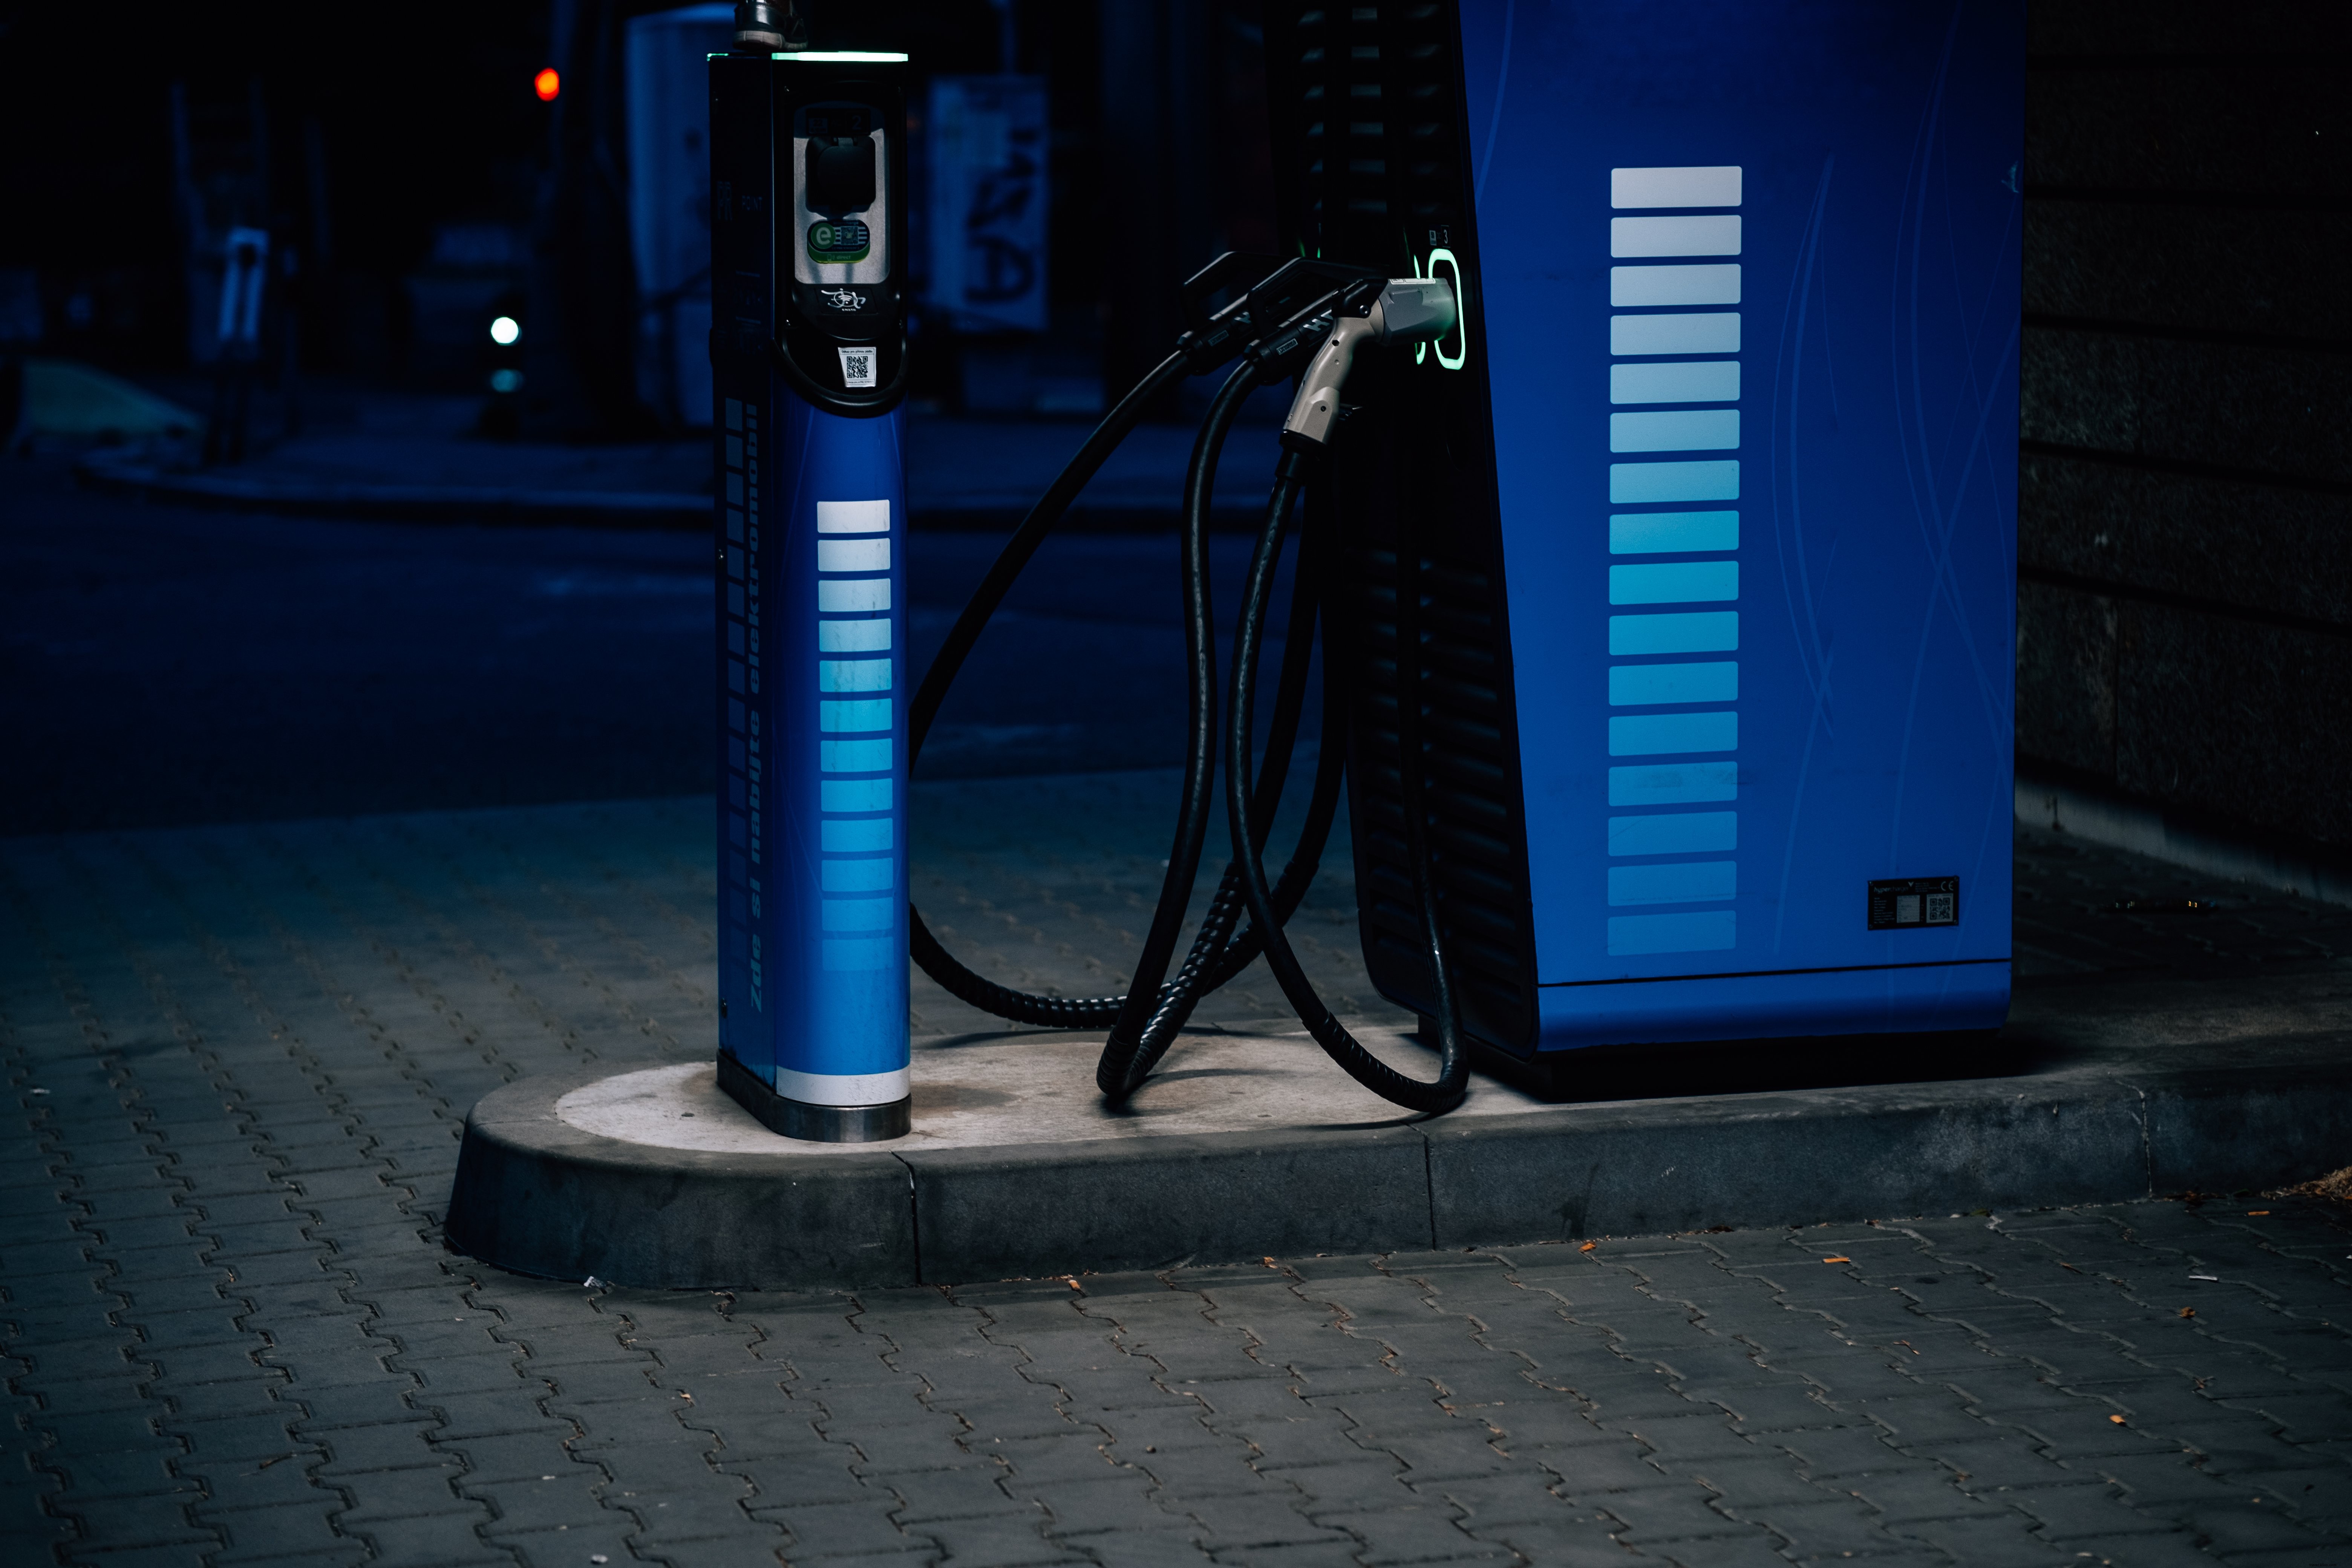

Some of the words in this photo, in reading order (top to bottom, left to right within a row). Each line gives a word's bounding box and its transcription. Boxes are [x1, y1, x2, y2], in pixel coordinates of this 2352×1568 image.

[851, 115, 862, 130] 2
[741, 195, 763, 211] POINT
[1443, 229, 1448, 244] 3
[746, 404, 760, 694] elektromobil
[749, 710, 761, 865] nabijte
[750, 877, 761, 919] si
[751, 934, 761, 1013] Zde
